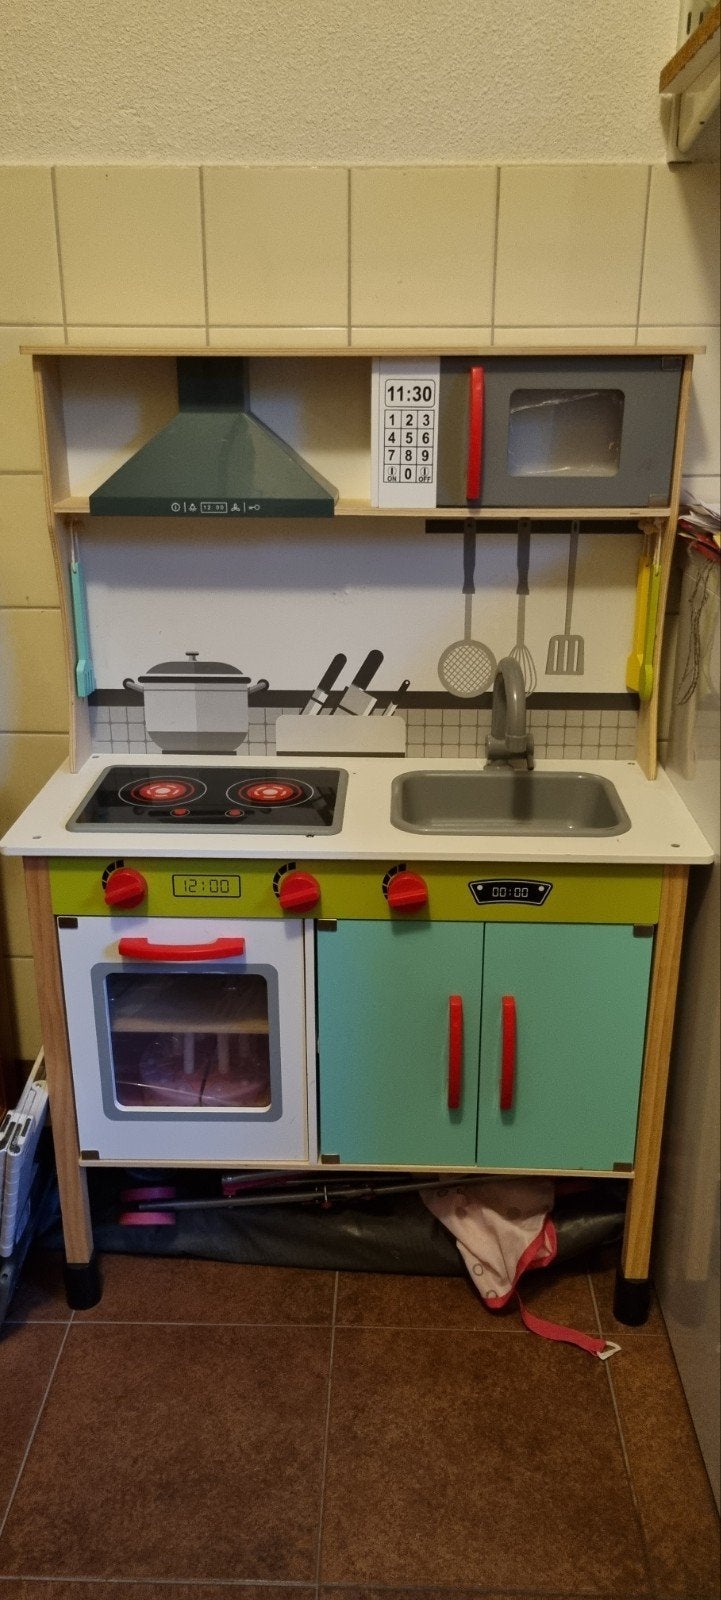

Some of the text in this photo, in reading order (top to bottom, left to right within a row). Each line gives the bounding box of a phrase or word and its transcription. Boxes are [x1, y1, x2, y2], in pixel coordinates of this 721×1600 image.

[387, 386, 432, 401] 11:30
[389, 414, 430, 426] 1 2 3
[387, 432, 430, 444] 4 5 6
[387, 449, 429, 461] 7 8 9
[404, 467, 412, 480] 0
[184, 879, 230, 893] 12:00
[492, 887, 529, 898] 00:00
